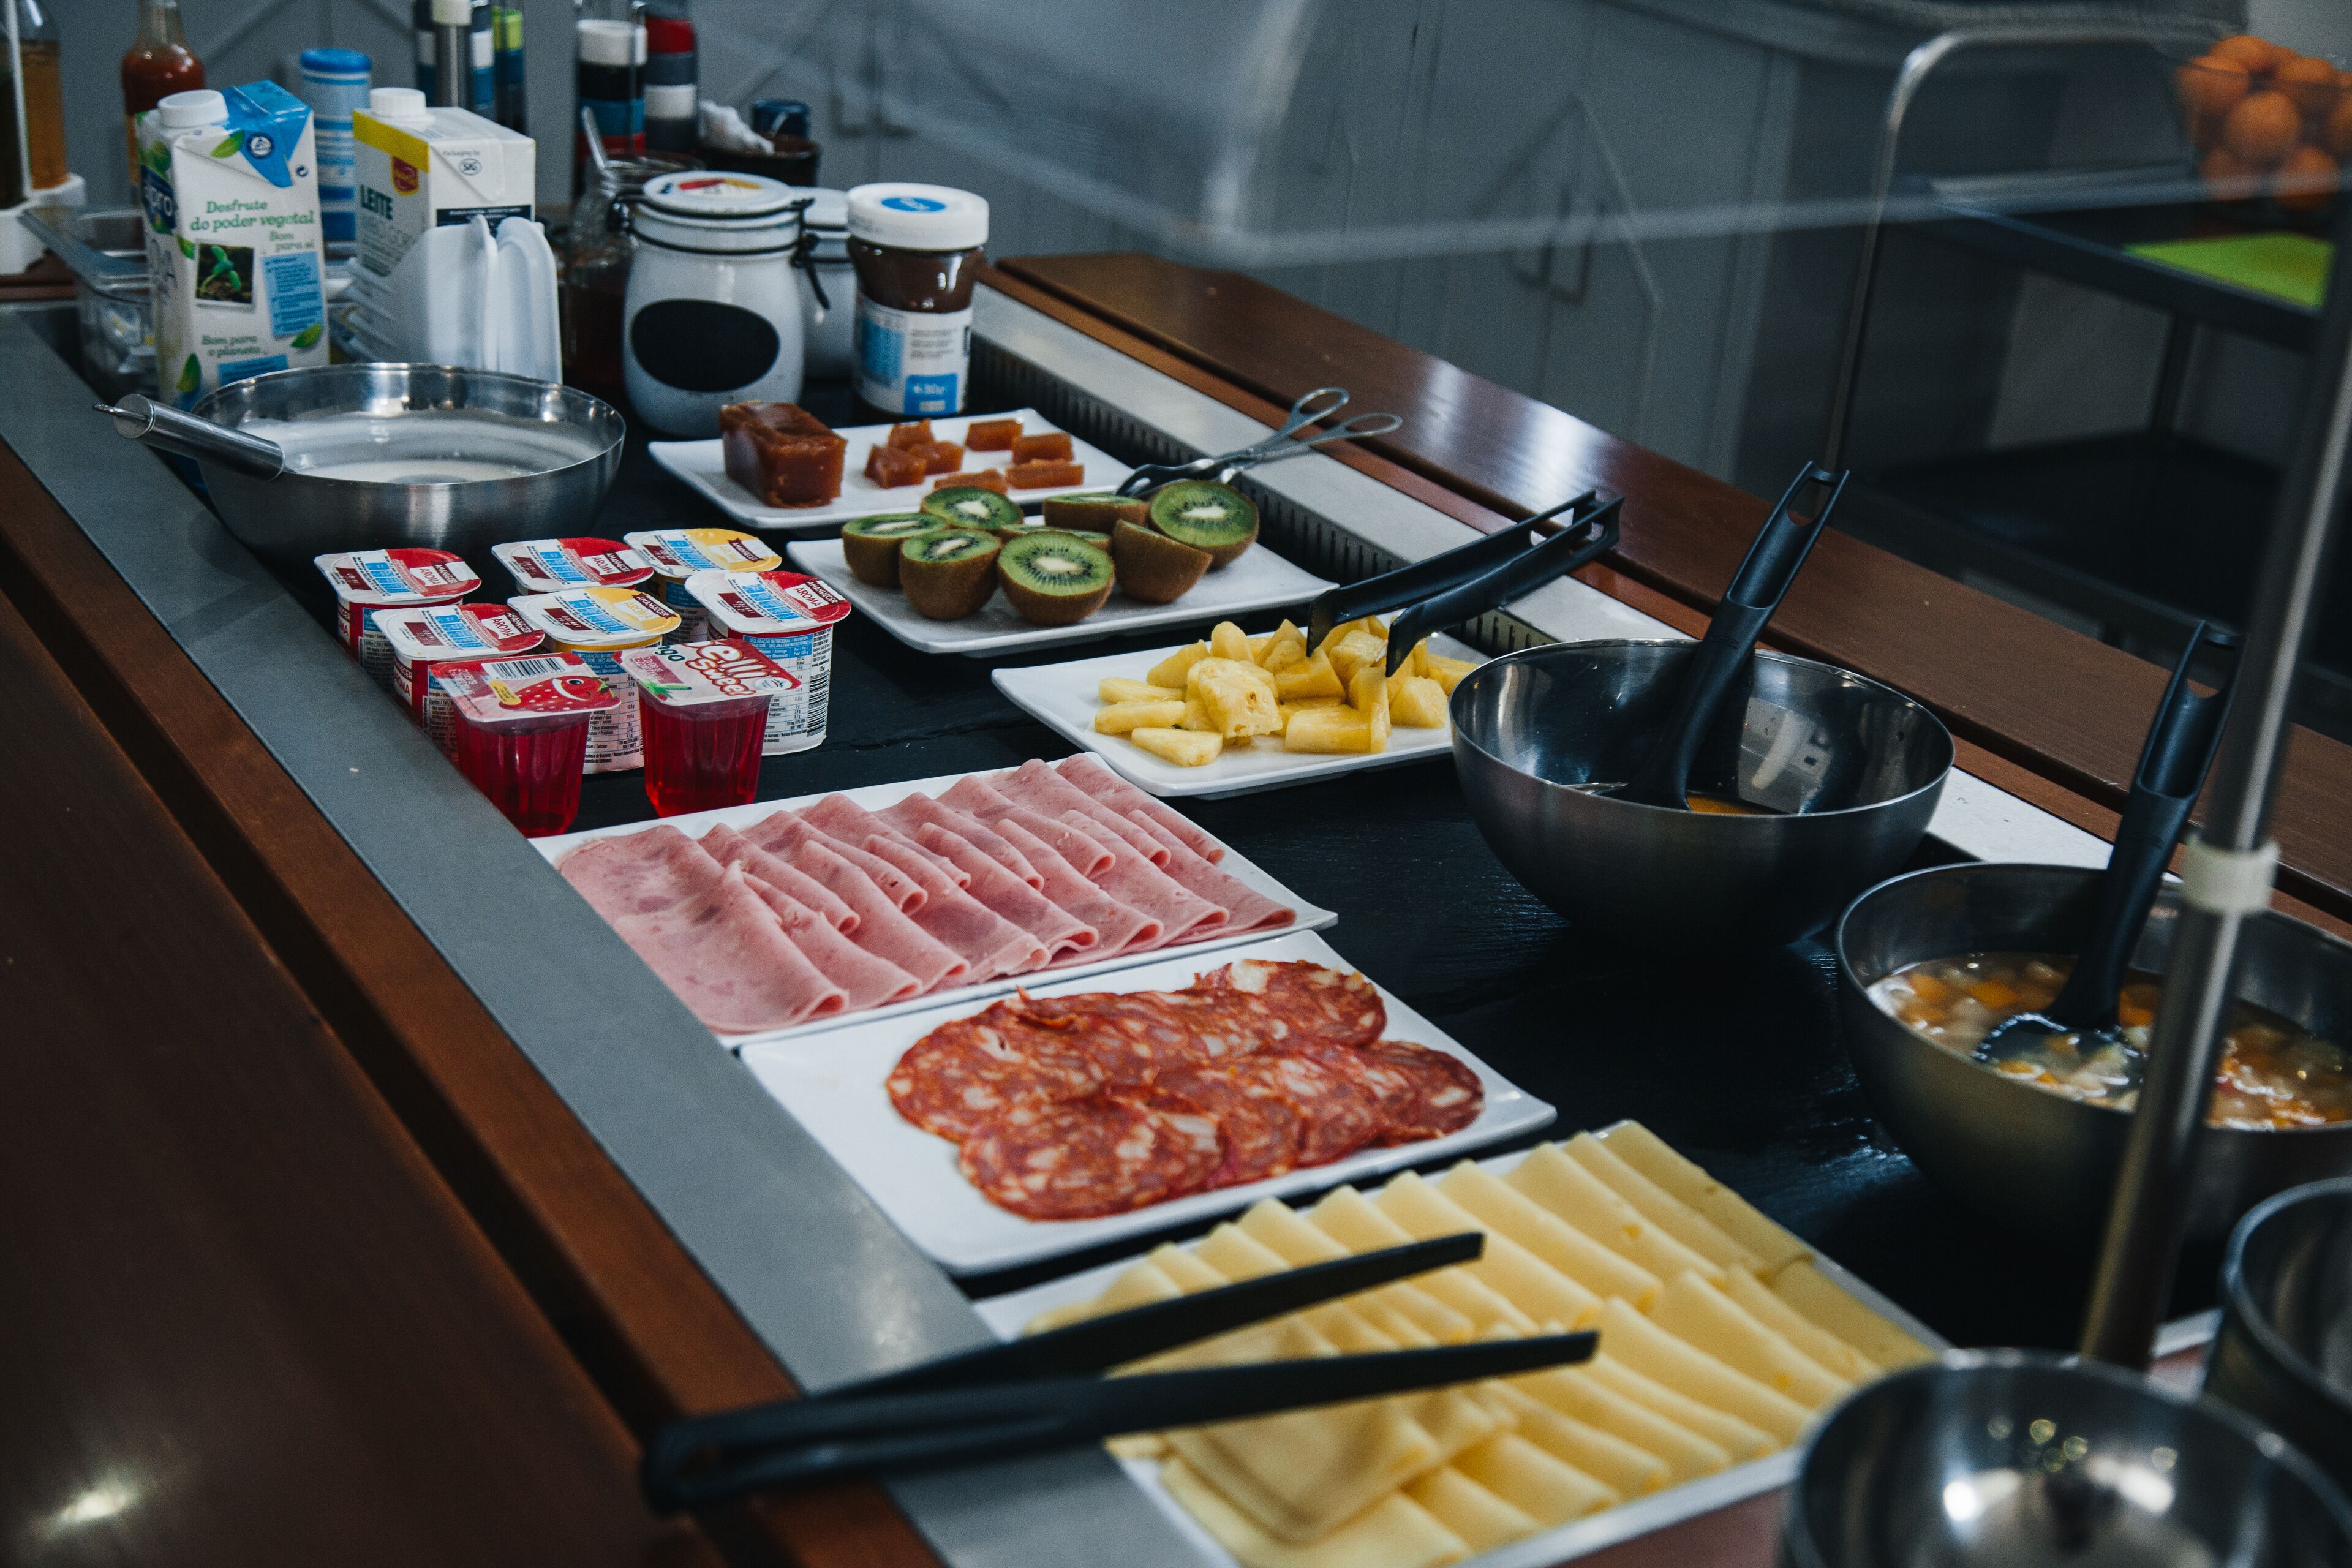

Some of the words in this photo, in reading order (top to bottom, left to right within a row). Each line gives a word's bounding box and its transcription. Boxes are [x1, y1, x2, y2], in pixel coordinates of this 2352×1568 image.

[206, 200, 268, 213] Desfrute
[360, 183, 394, 221] LEITE
[190, 217, 209, 230] do
[212, 214, 257, 232] poder
[260, 210, 314, 227] vegetal
[734, 541, 761, 562] AMANHECER
[592, 557, 615, 573] AROMA
[607, 553, 631, 573] AMANHECER
[419, 568, 441, 586] AROMA
[794, 587, 823, 607] AROMA
[807, 581, 839, 604] AMANHECER
[638, 596, 669, 617] AMANHECER
[490, 618, 516, 637] AROMA
[507, 612, 532, 633] AMANHECER
